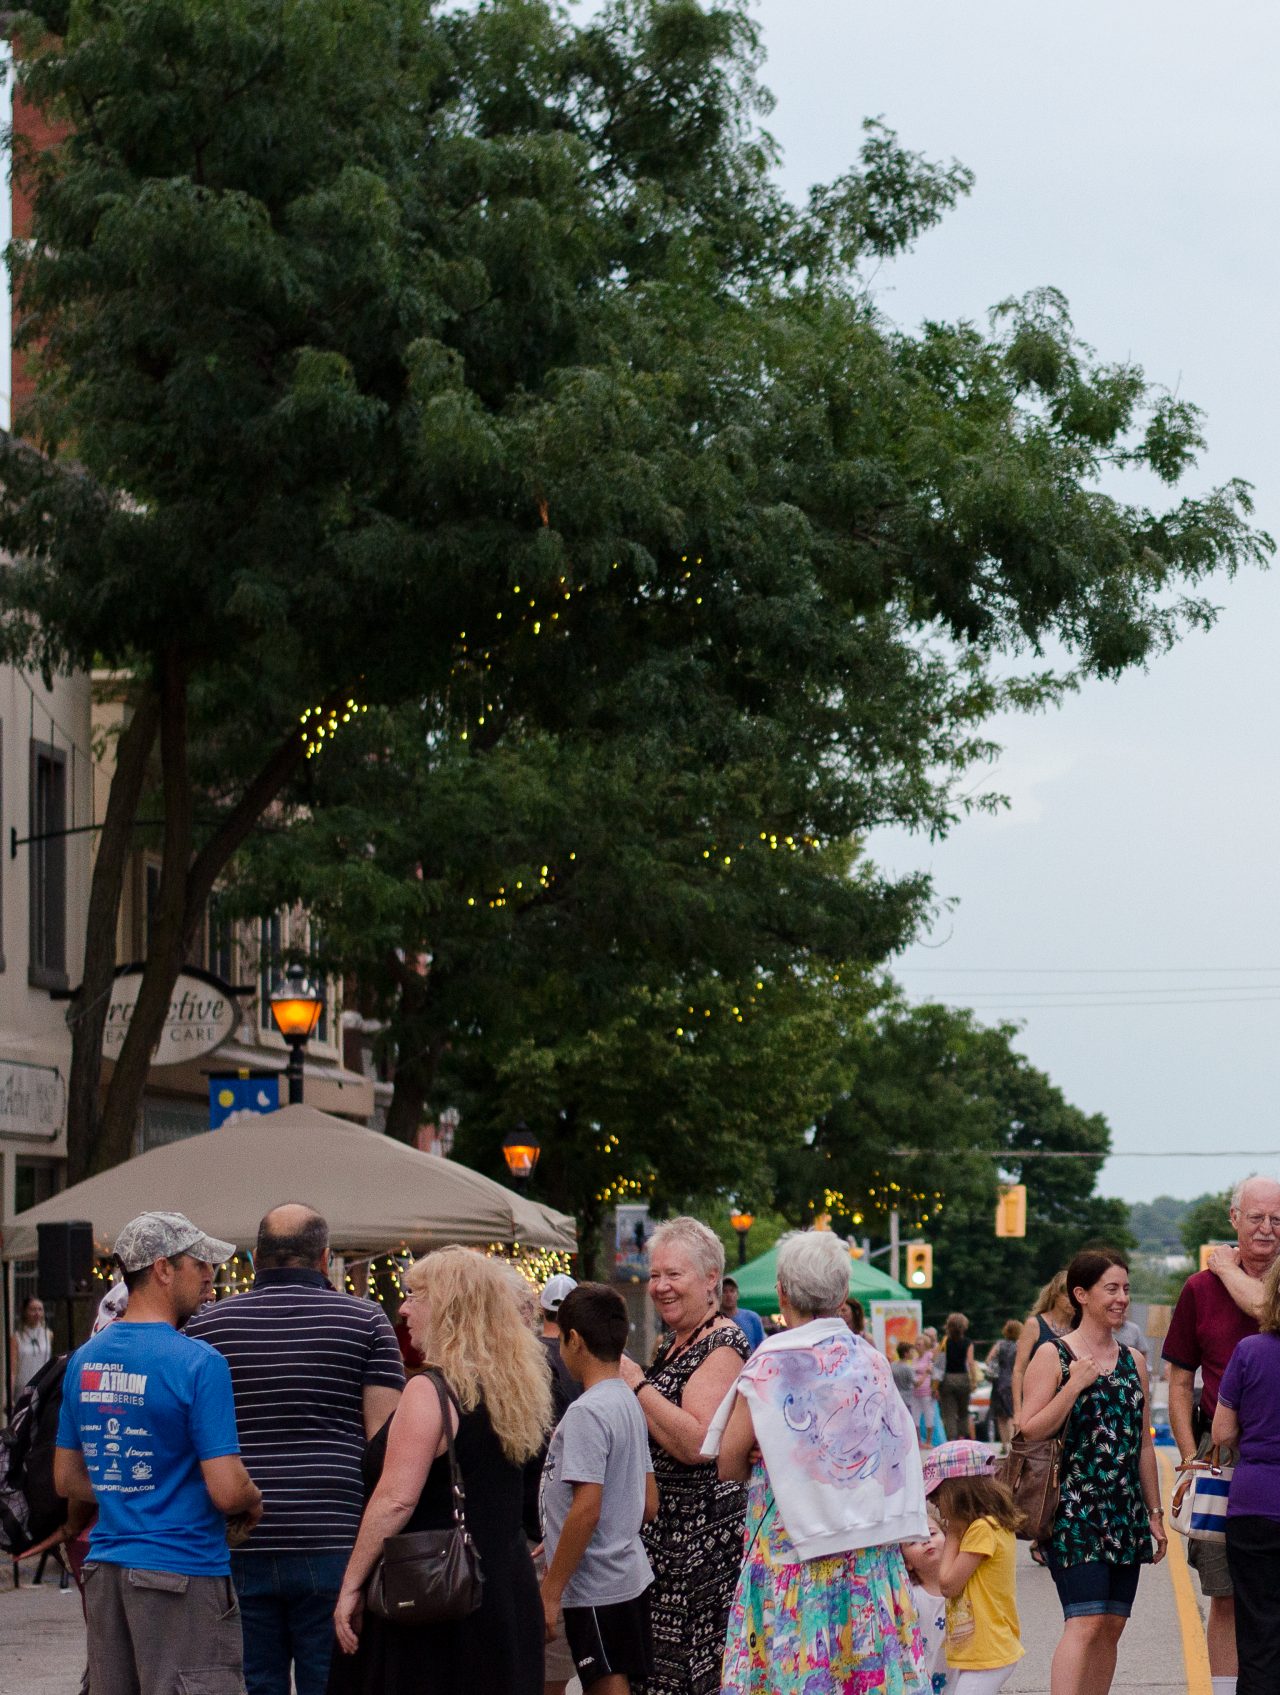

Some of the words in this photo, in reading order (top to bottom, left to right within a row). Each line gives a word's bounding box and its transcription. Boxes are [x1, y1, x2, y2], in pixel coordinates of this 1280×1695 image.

[170, 1028, 214, 1042] CARE
[82, 1363, 124, 1371] SUBARU
[81, 1371, 147, 1395] ATHLON
[113, 1393, 145, 1407] SERIES
